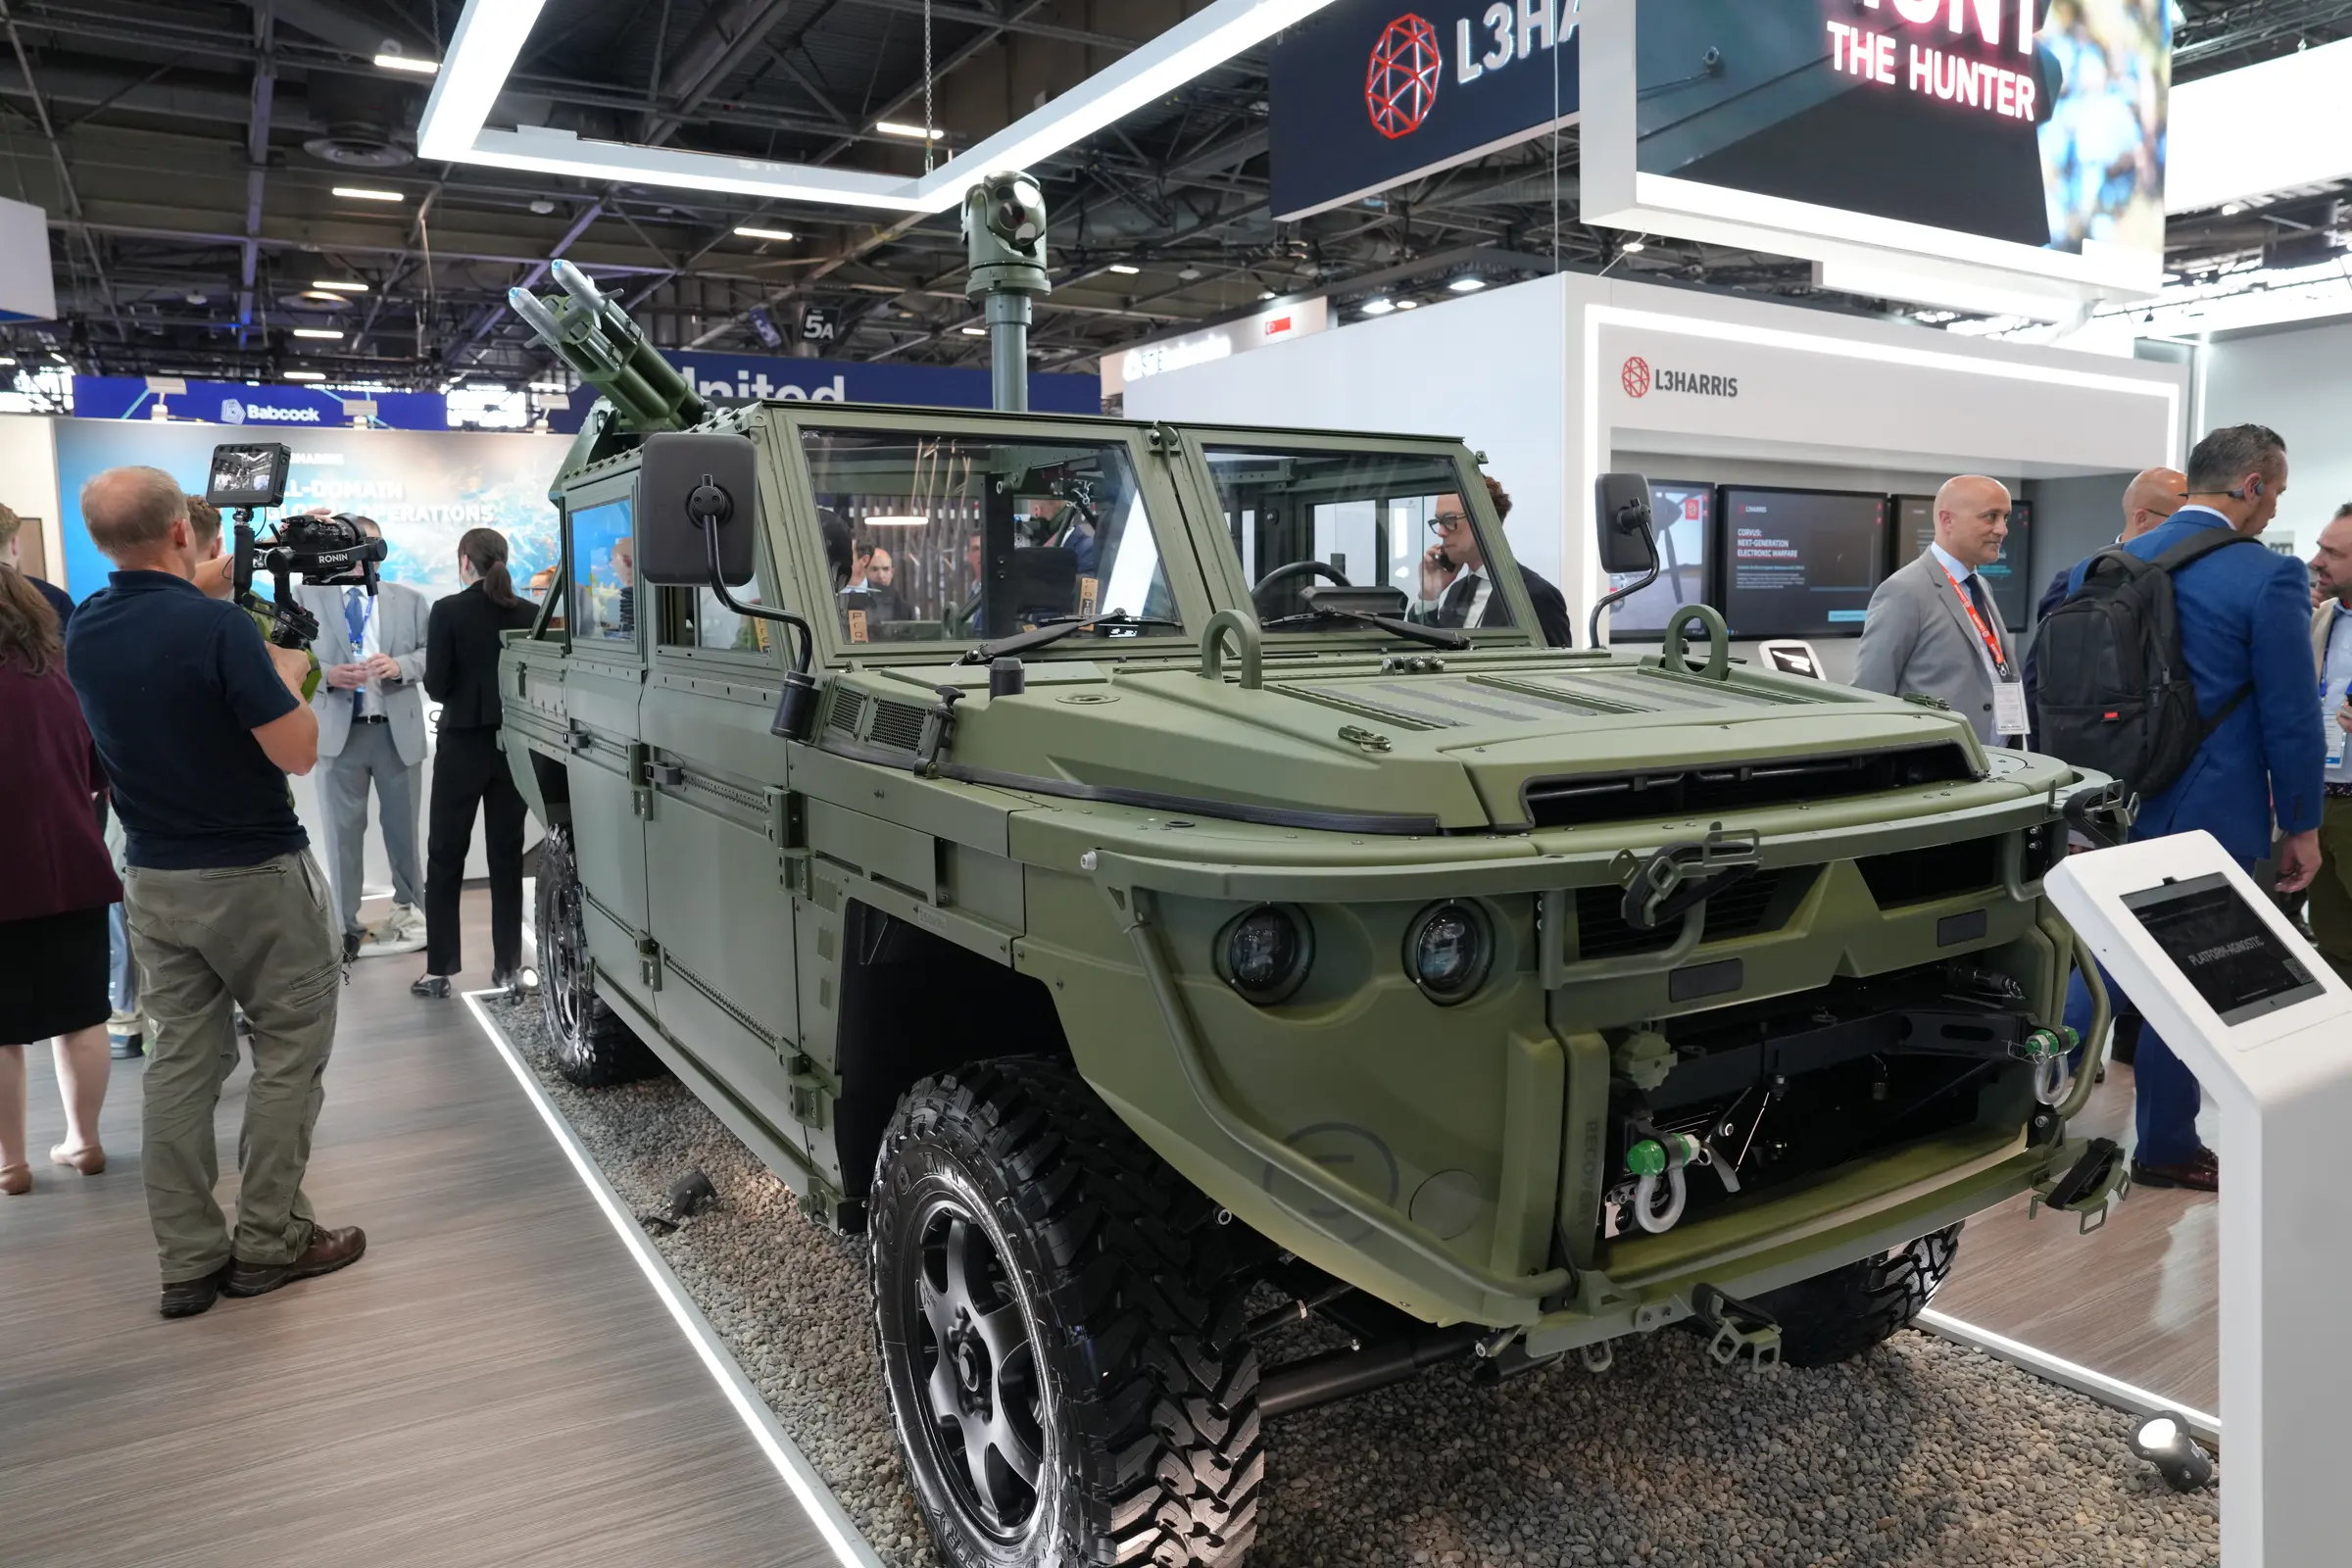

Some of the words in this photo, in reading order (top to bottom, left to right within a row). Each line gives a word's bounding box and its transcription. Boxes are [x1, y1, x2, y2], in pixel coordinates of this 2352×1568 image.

[1827, 21, 1896, 85] THE
[1909, 43, 2036, 122] HUNTER
[803, 315, 835, 340] 5A
[678, 366, 845, 403] nitd
[1654, 368, 1739, 398] L3HARRIS
[247, 404, 321, 422] Babcock
[283, 479, 404, 499] L-DOMAIN
[1737, 528, 1763, 537] CORVUS:
[1737, 538, 1790, 548] NEXT-GENERATION
[318, 553, 349, 564] RONIN
[1737, 549, 1772, 558] ELECTRONIC
[1772, 549, 1799, 558] WARFARE
[2187, 935, 2265, 966] PLATFORM-AGNOSTIC
[1579, 1120, 1598, 1227] RECOVERY
